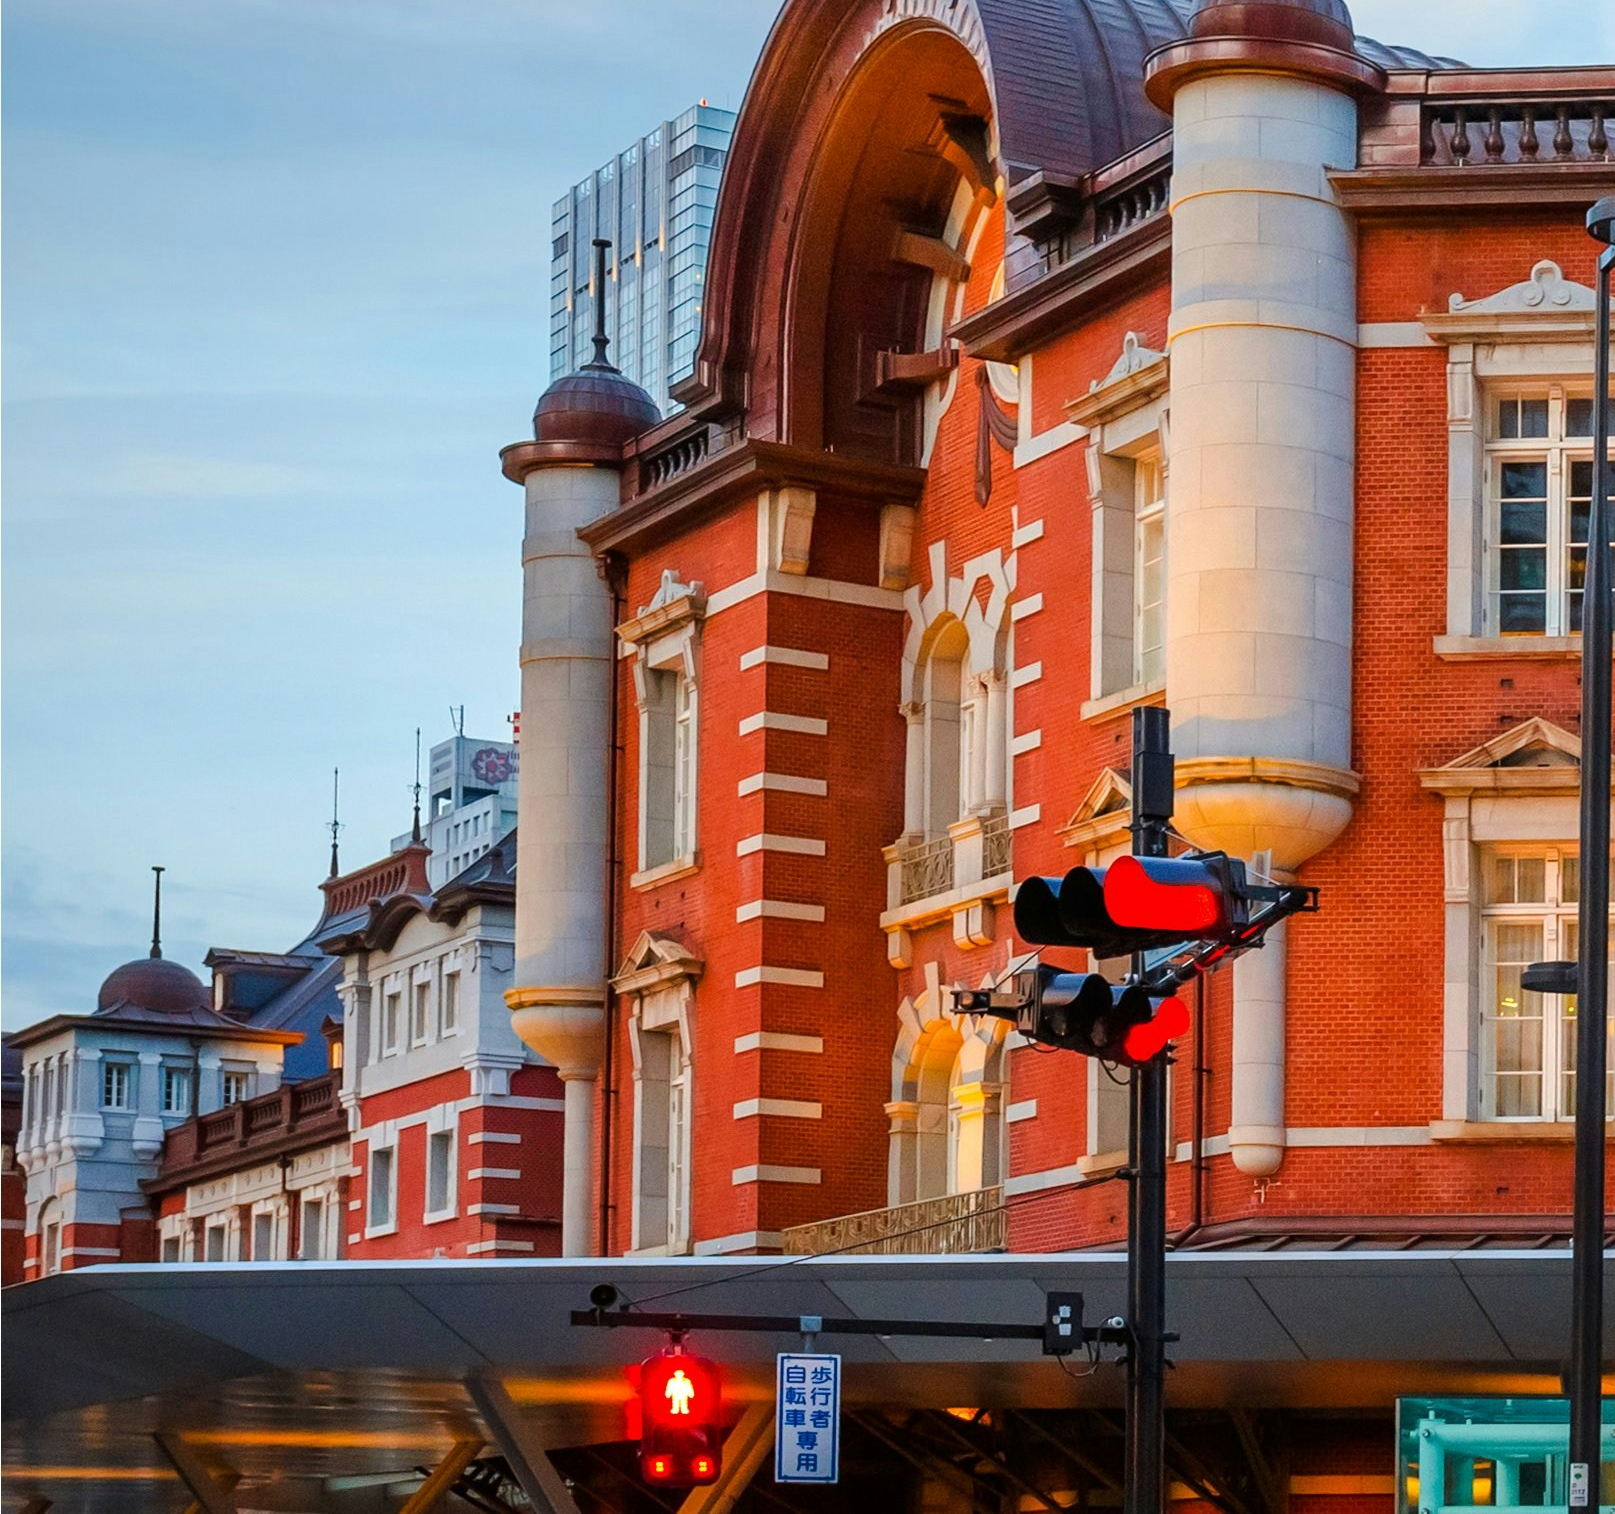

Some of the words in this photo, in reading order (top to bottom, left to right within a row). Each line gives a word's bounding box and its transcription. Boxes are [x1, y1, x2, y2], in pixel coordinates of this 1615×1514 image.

[784, 1364, 807, 1428] 自転車
[809, 1365, 833, 1429] 歩行者
[796, 1430, 819, 1473] 専用
